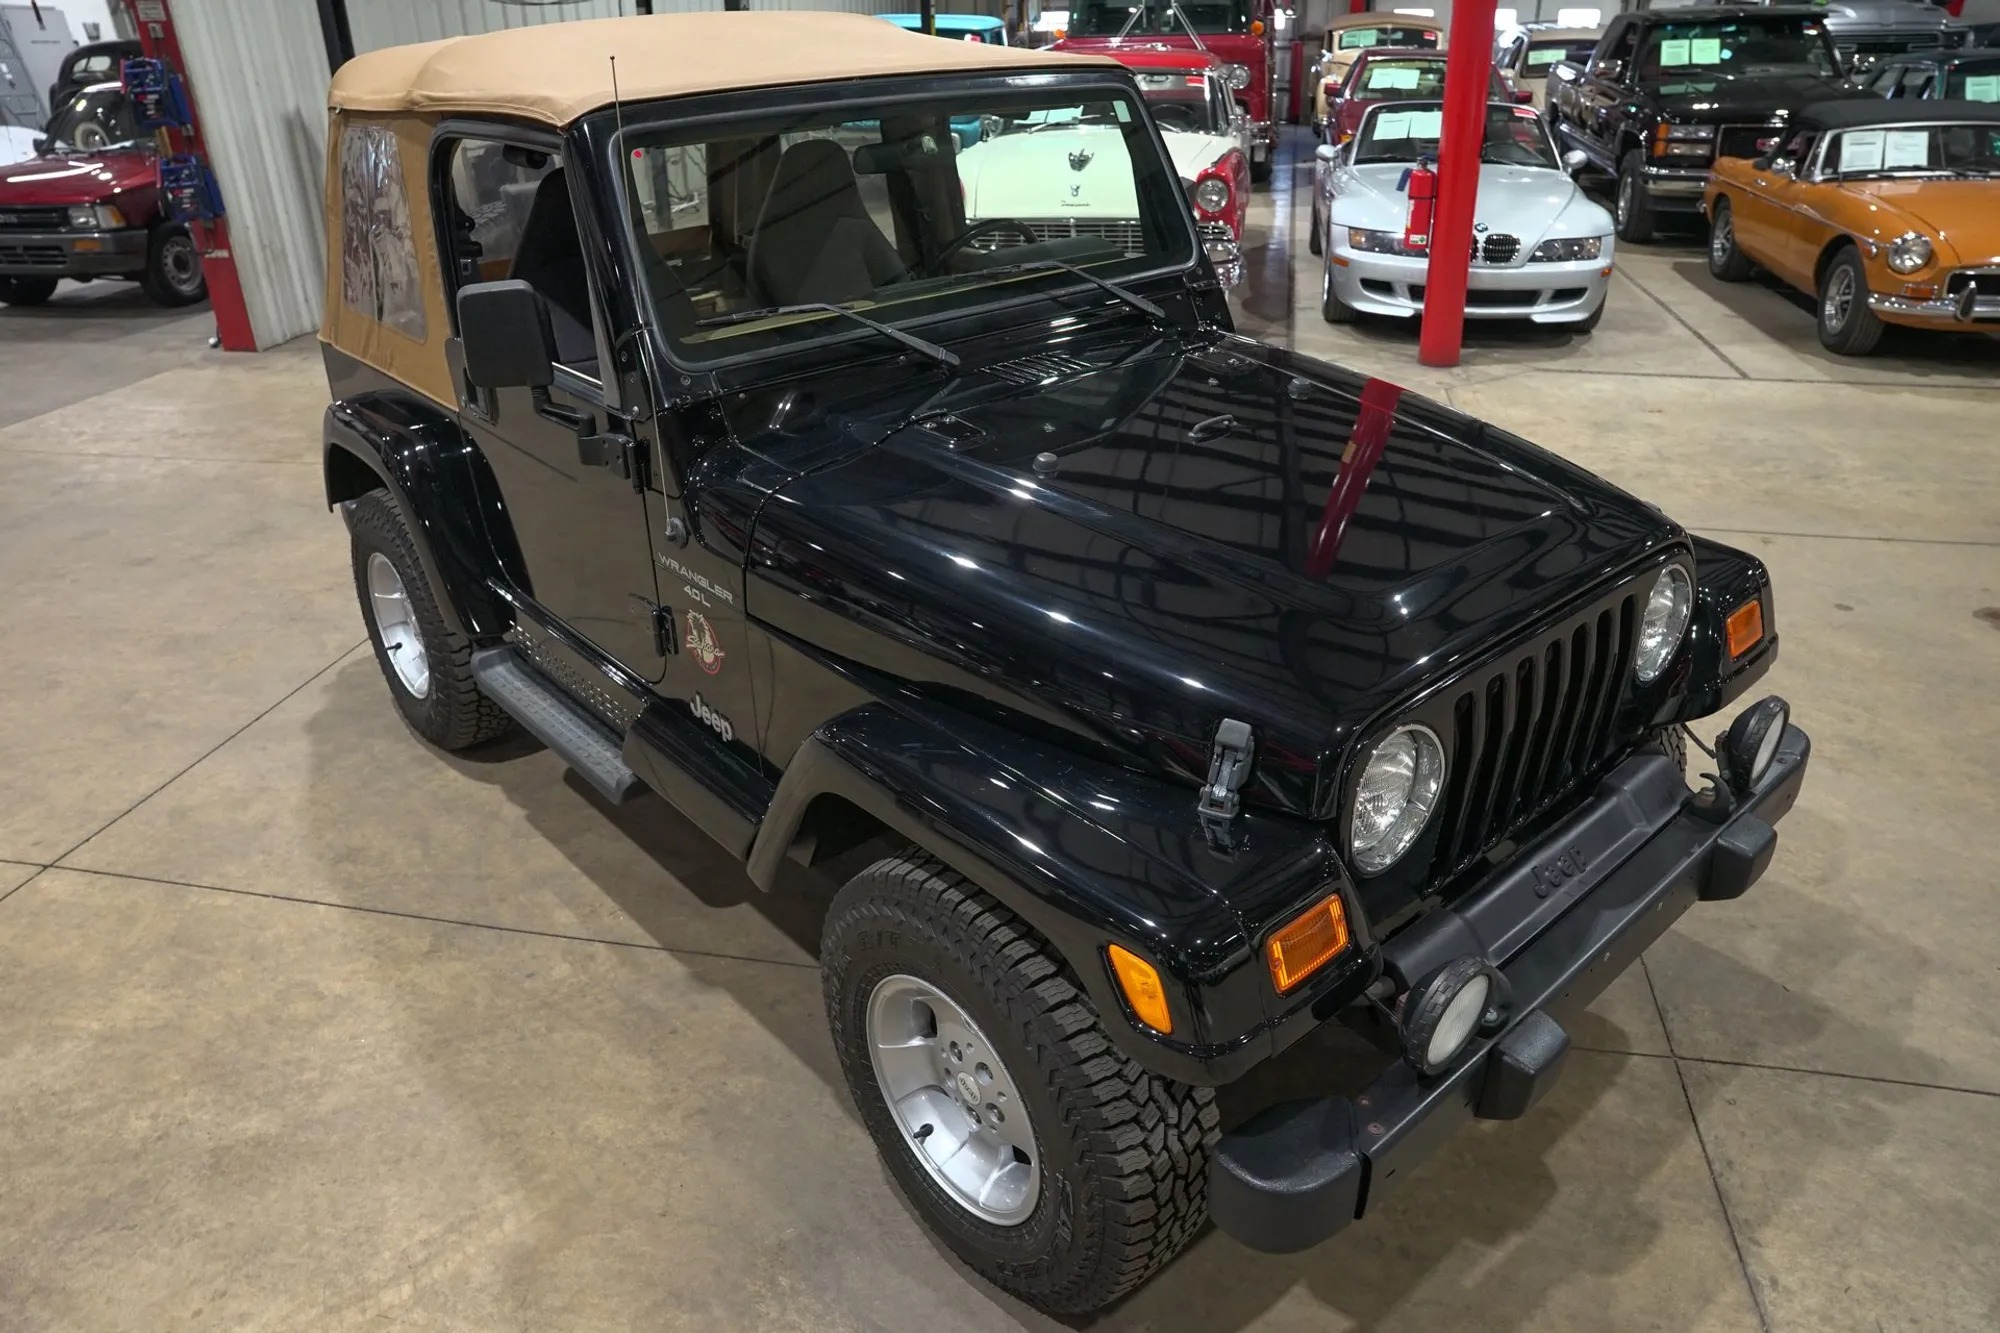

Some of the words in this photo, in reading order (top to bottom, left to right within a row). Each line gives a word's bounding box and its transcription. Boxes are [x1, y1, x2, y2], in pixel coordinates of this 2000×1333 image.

[658, 552, 734, 608] WRANGLER
[690, 694, 732, 742] Jeep
[1533, 846, 1587, 899] Jeep
